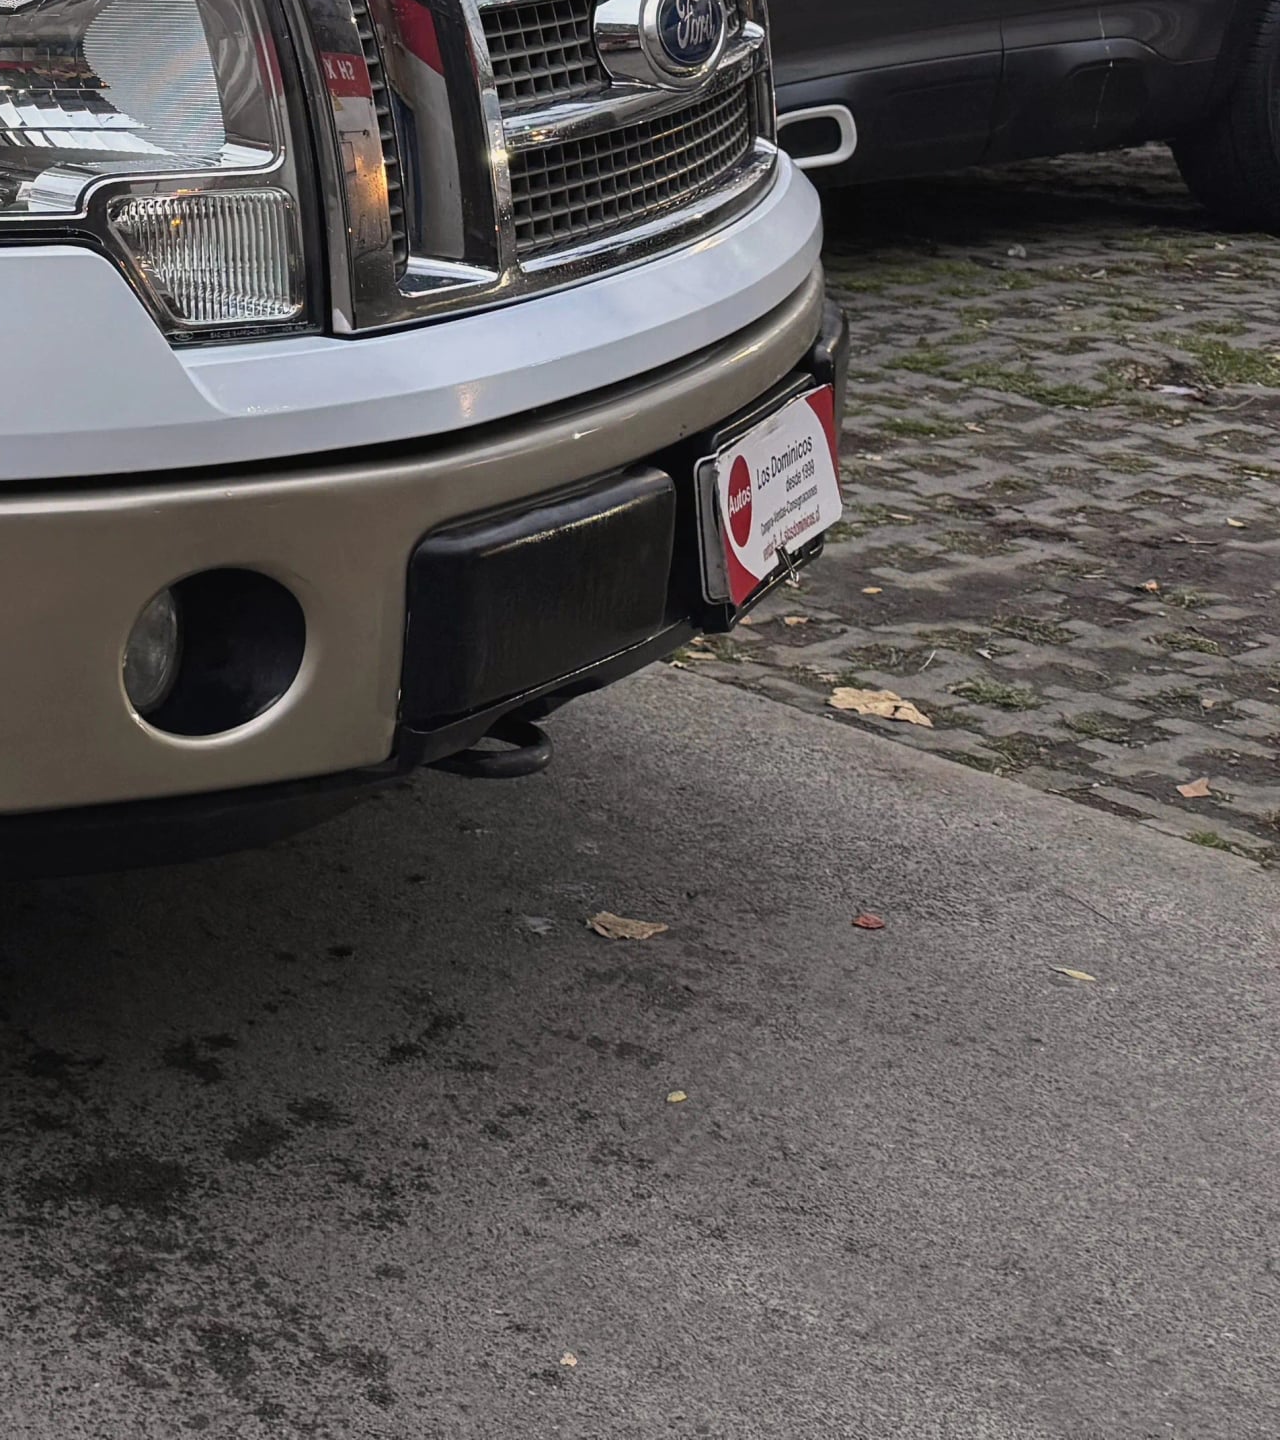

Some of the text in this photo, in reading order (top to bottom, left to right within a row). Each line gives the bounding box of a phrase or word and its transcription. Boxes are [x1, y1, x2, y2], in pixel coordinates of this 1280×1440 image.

[756, 436, 813, 491] Los Dominicos
[728, 485, 752, 518] Autos
